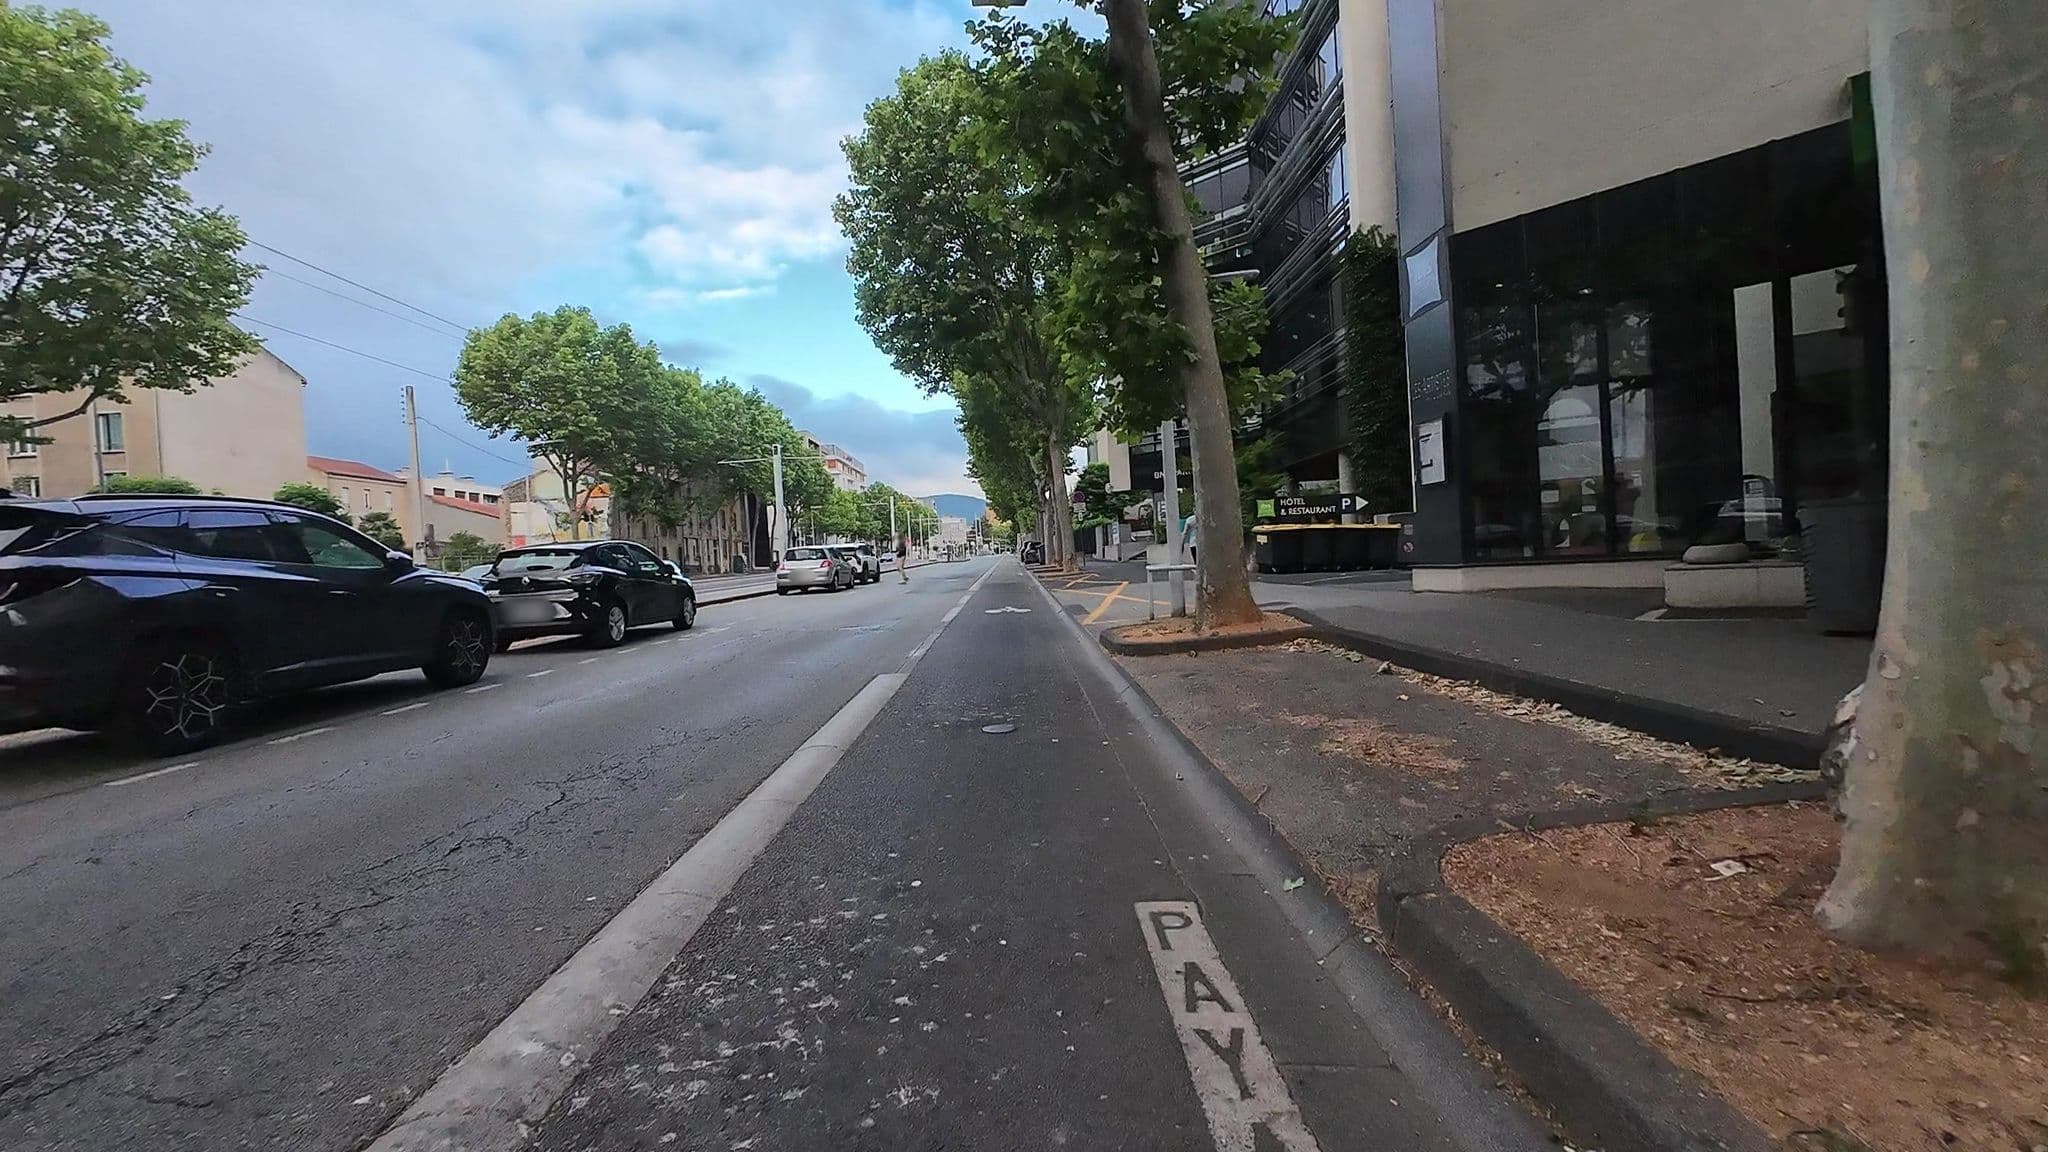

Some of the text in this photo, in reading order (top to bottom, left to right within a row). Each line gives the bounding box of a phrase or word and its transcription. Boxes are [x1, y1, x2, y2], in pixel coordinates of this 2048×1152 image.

[1342, 498, 1351, 510] P
[1288, 506, 1336, 515] RESTAURANT
[1149, 911, 1286, 1152] PAY
